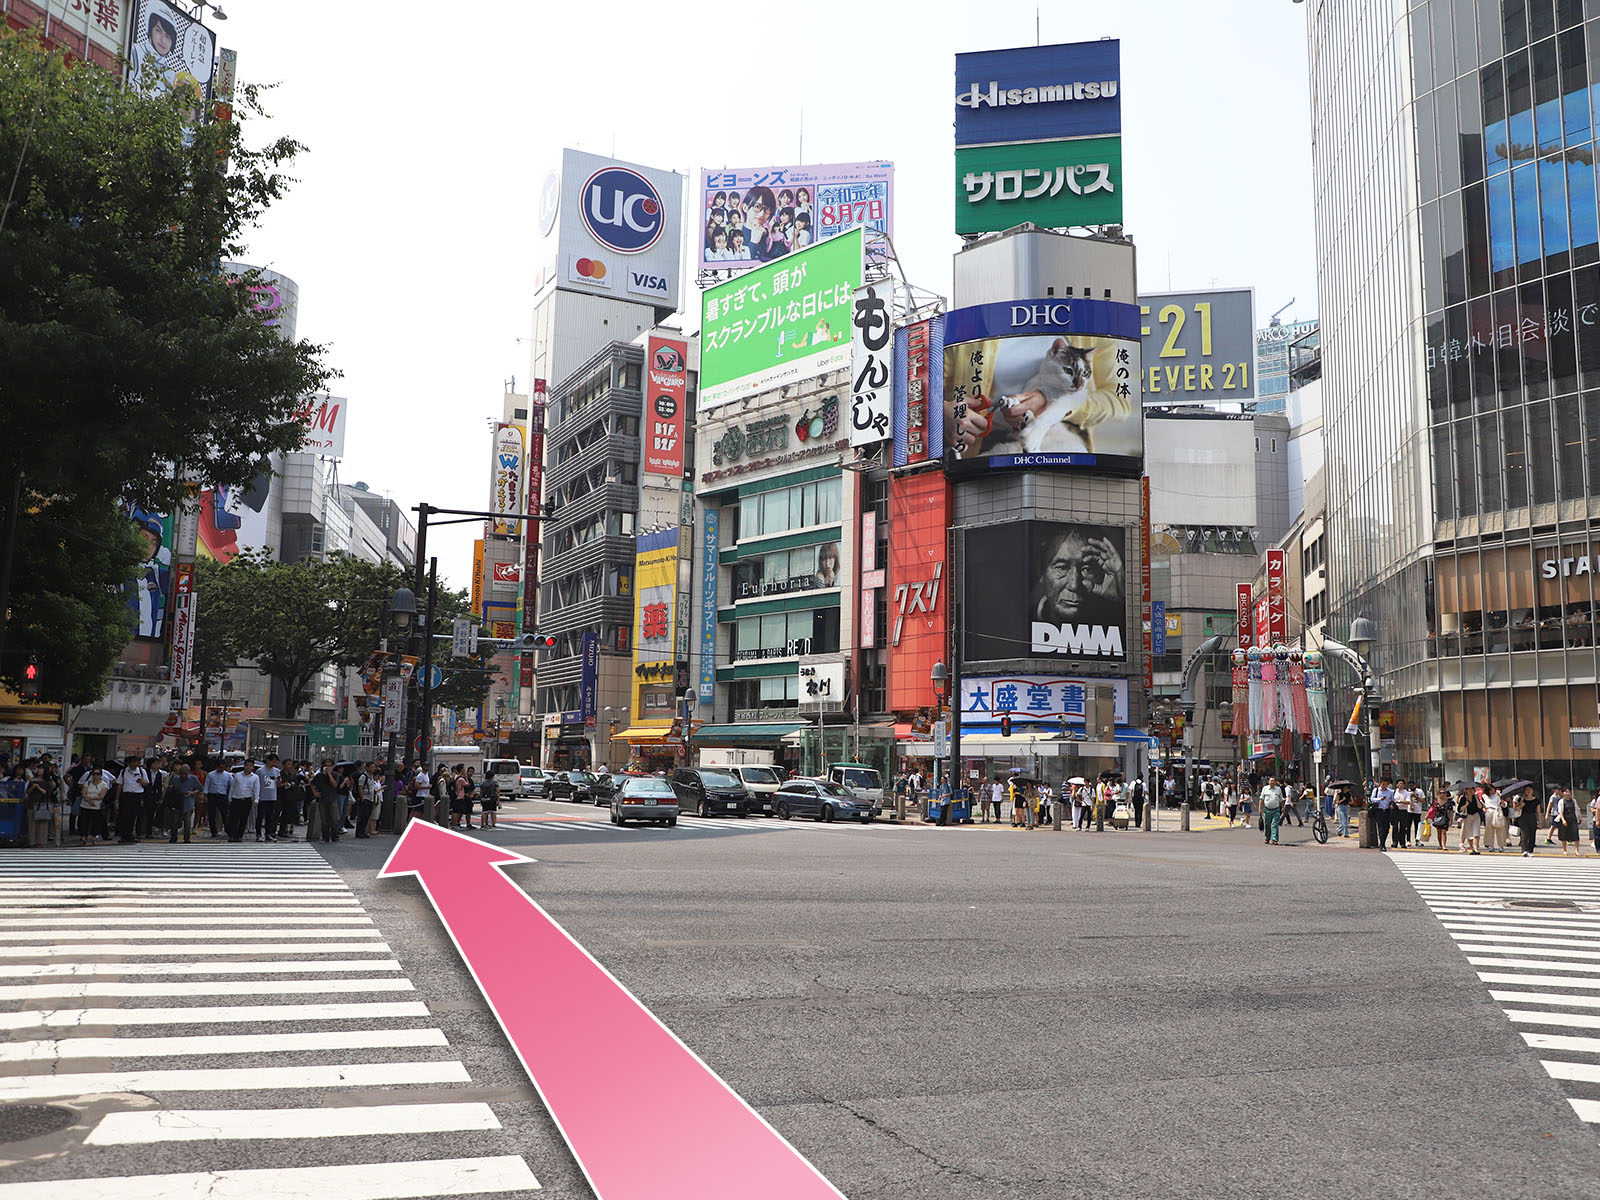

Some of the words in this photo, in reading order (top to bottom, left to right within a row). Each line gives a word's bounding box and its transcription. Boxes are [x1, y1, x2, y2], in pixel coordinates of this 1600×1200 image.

[956, 81, 1118, 108] Hisamitsu
[706, 169, 789, 188] ビヨーンズ
[819, 183, 884, 204] 令和元年
[963, 163, 1114, 203] サロンパス
[591, 185, 656, 233] UC
[821, 200, 883, 226] 8月7日
[630, 271, 668, 292] VISA
[705, 281, 851, 353] スクランブルな日には
[1010, 304, 1071, 327] DHC
[853, 287, 890, 437] もんじゃ
[969, 350, 985, 397] 俺より
[1115, 348, 1131, 399] 俺の体
[1221, 362, 1248, 389] 21
[907, 325, 926, 456] 三千里薬品
[291, 398, 340, 434] HM
[655, 422, 676, 436] B1F
[953, 384, 967, 453] 管理しろ
[654, 437, 677, 451] B2F
[1014, 456, 1034, 465] DHC
[1035, 455, 1071, 465] Channel
[703, 533, 717, 632] サマーフルーツギフト
[1542, 554, 1600, 580] STA
[742, 577, 810, 597] Euphoria
[892, 561, 944, 647] クスリ
[1269, 559, 1283, 624] カラオケ
[643, 602, 668, 639] 薬
[1032, 621, 1124, 657] DMM
[386, 682, 397, 728] 道玄坂
[969, 684, 1117, 713] 大盛堂書
